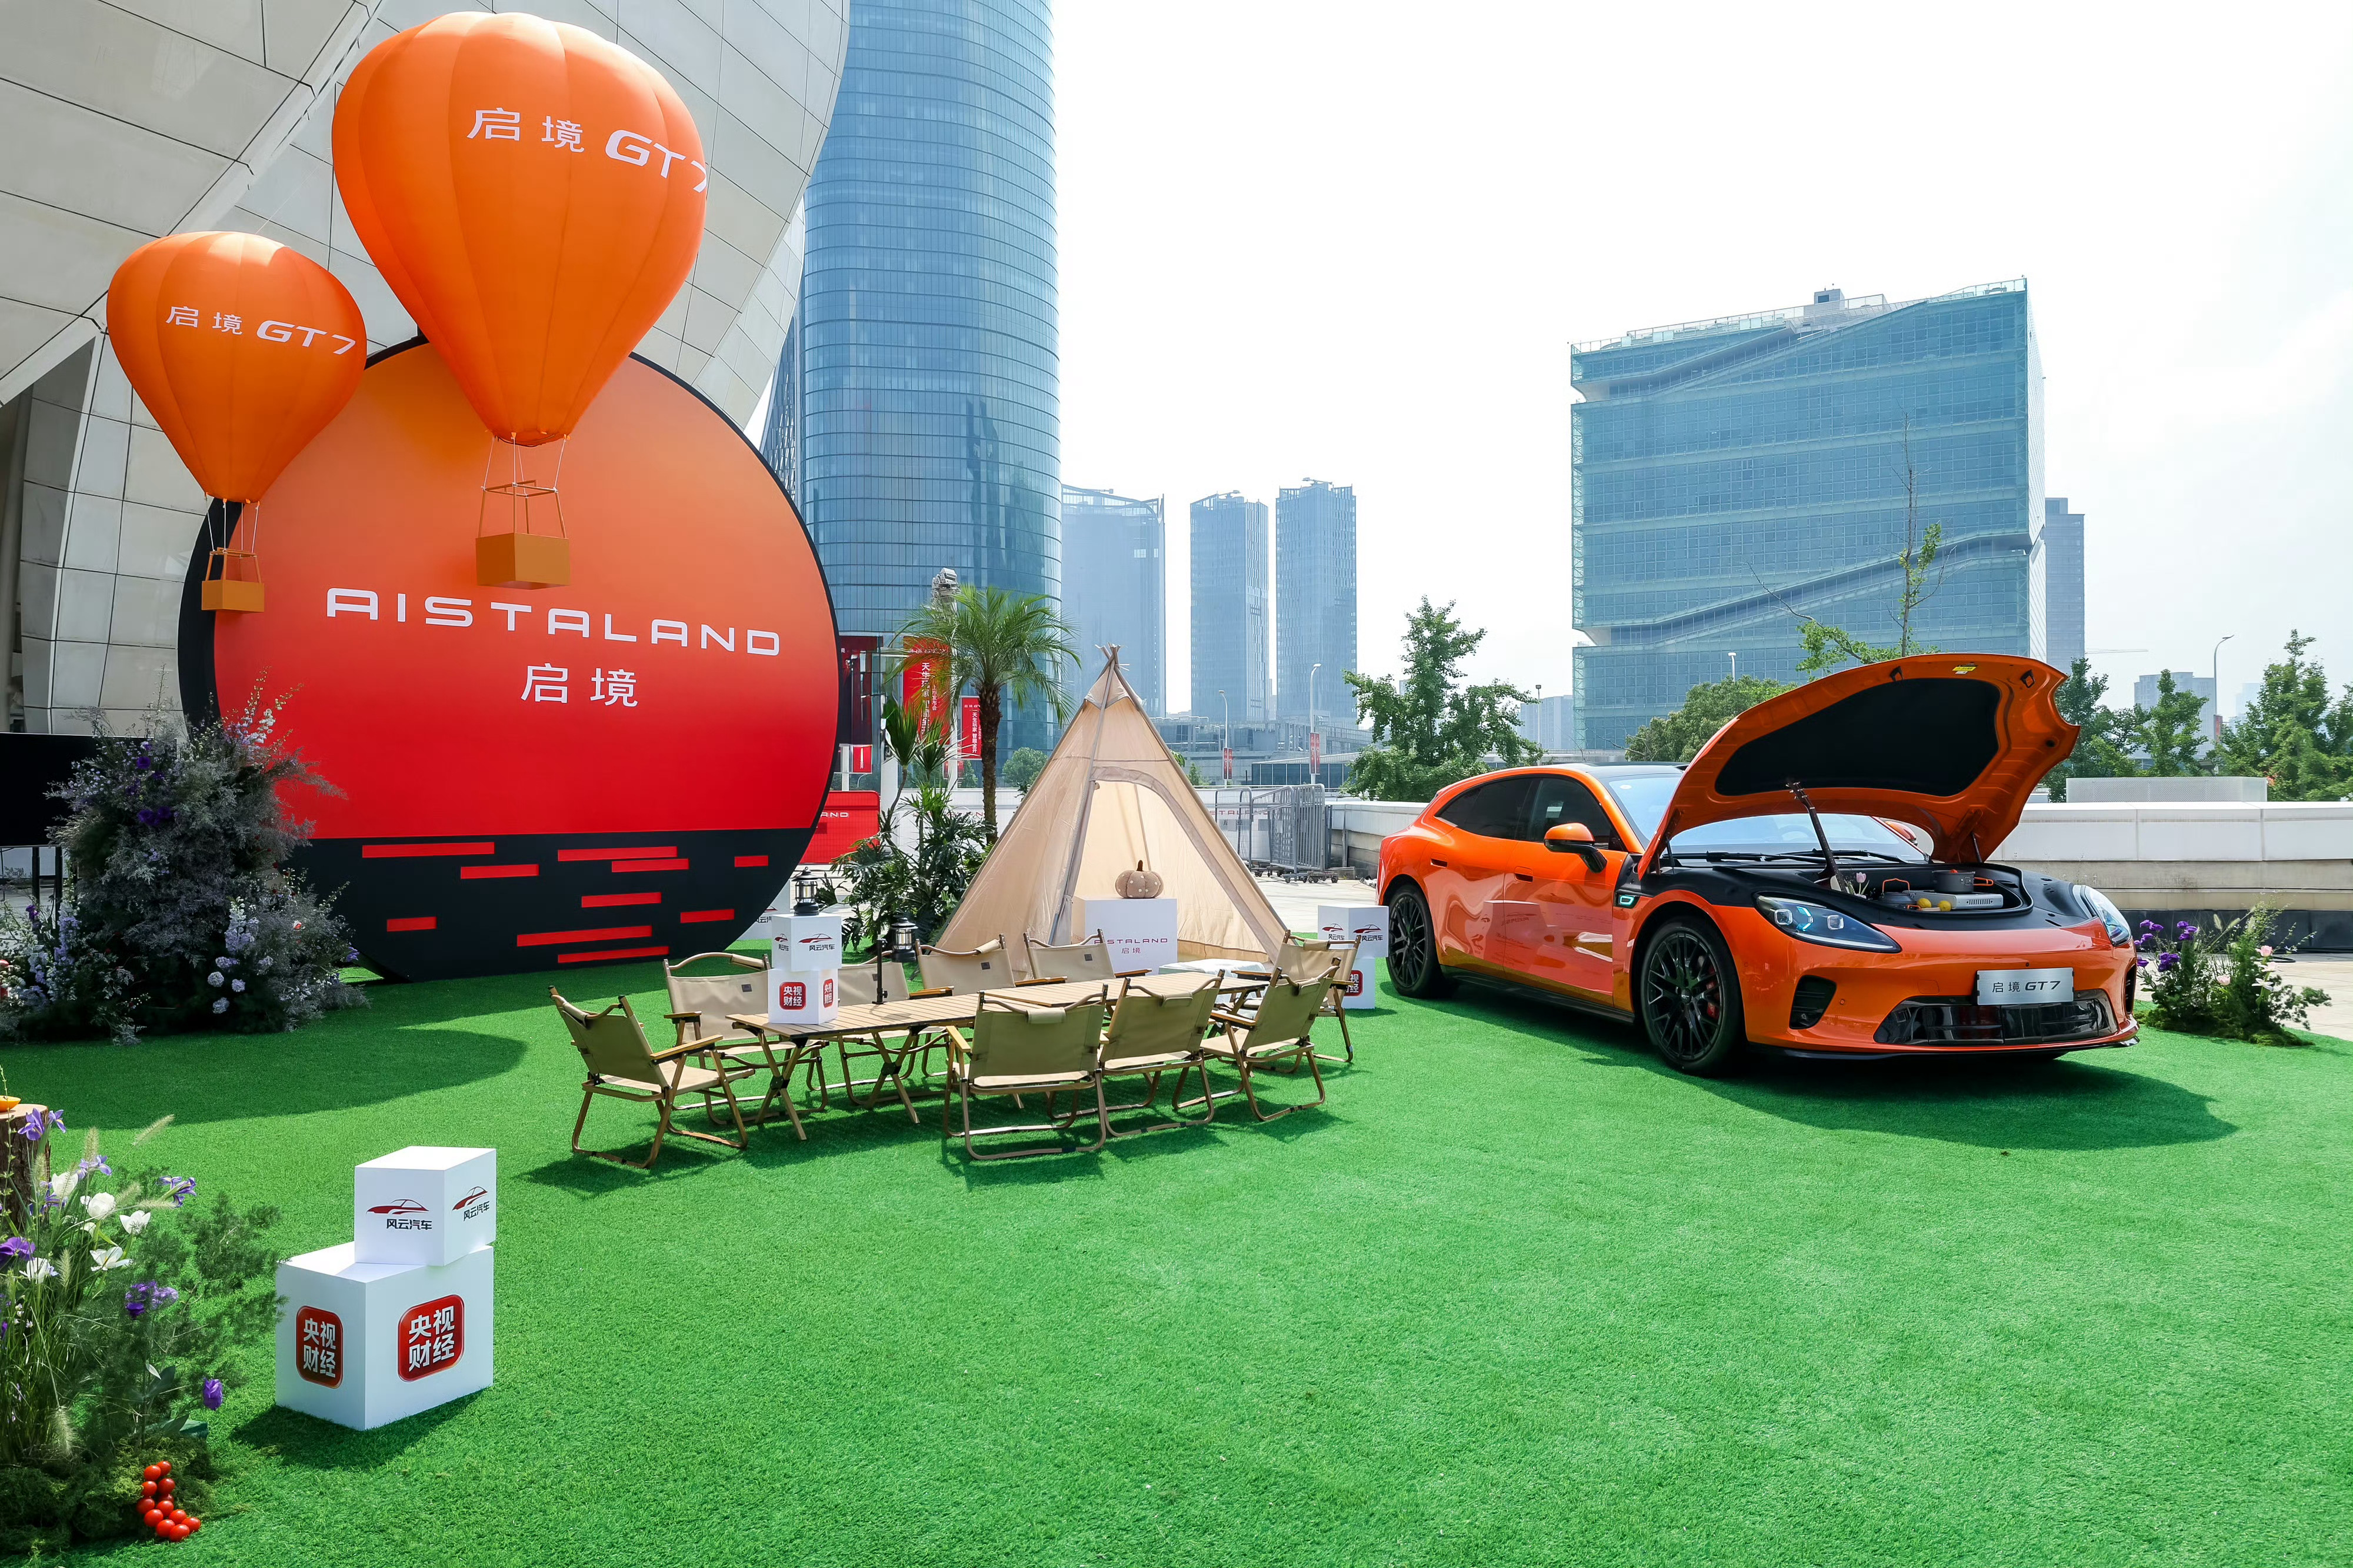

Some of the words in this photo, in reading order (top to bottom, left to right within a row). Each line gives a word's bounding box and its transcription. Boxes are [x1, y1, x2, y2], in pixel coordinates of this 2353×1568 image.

[466, 107, 585, 153] 启境
[605, 129, 707, 193] GT7
[165, 306, 243, 335] 启境
[256, 320, 356, 355] GT7
[326, 588, 781, 656] AISTALAND
[521, 662, 638, 707] 启境
[784, 986, 802, 996] 央视
[1349, 973, 1359, 983] 视
[1992, 982, 2021, 993] 启境
[2025, 980, 2061, 991] GT7
[784, 996, 802, 1006] 财经
[386, 1218, 432, 1230] 风云汽车
[464, 1201, 489, 1222] 风云汽车
[304, 1318, 336, 1350] 央视
[409, 1306, 455, 1343] 央视
[303, 1345, 336, 1378] 财经
[409, 1333, 455, 1372] 财经
